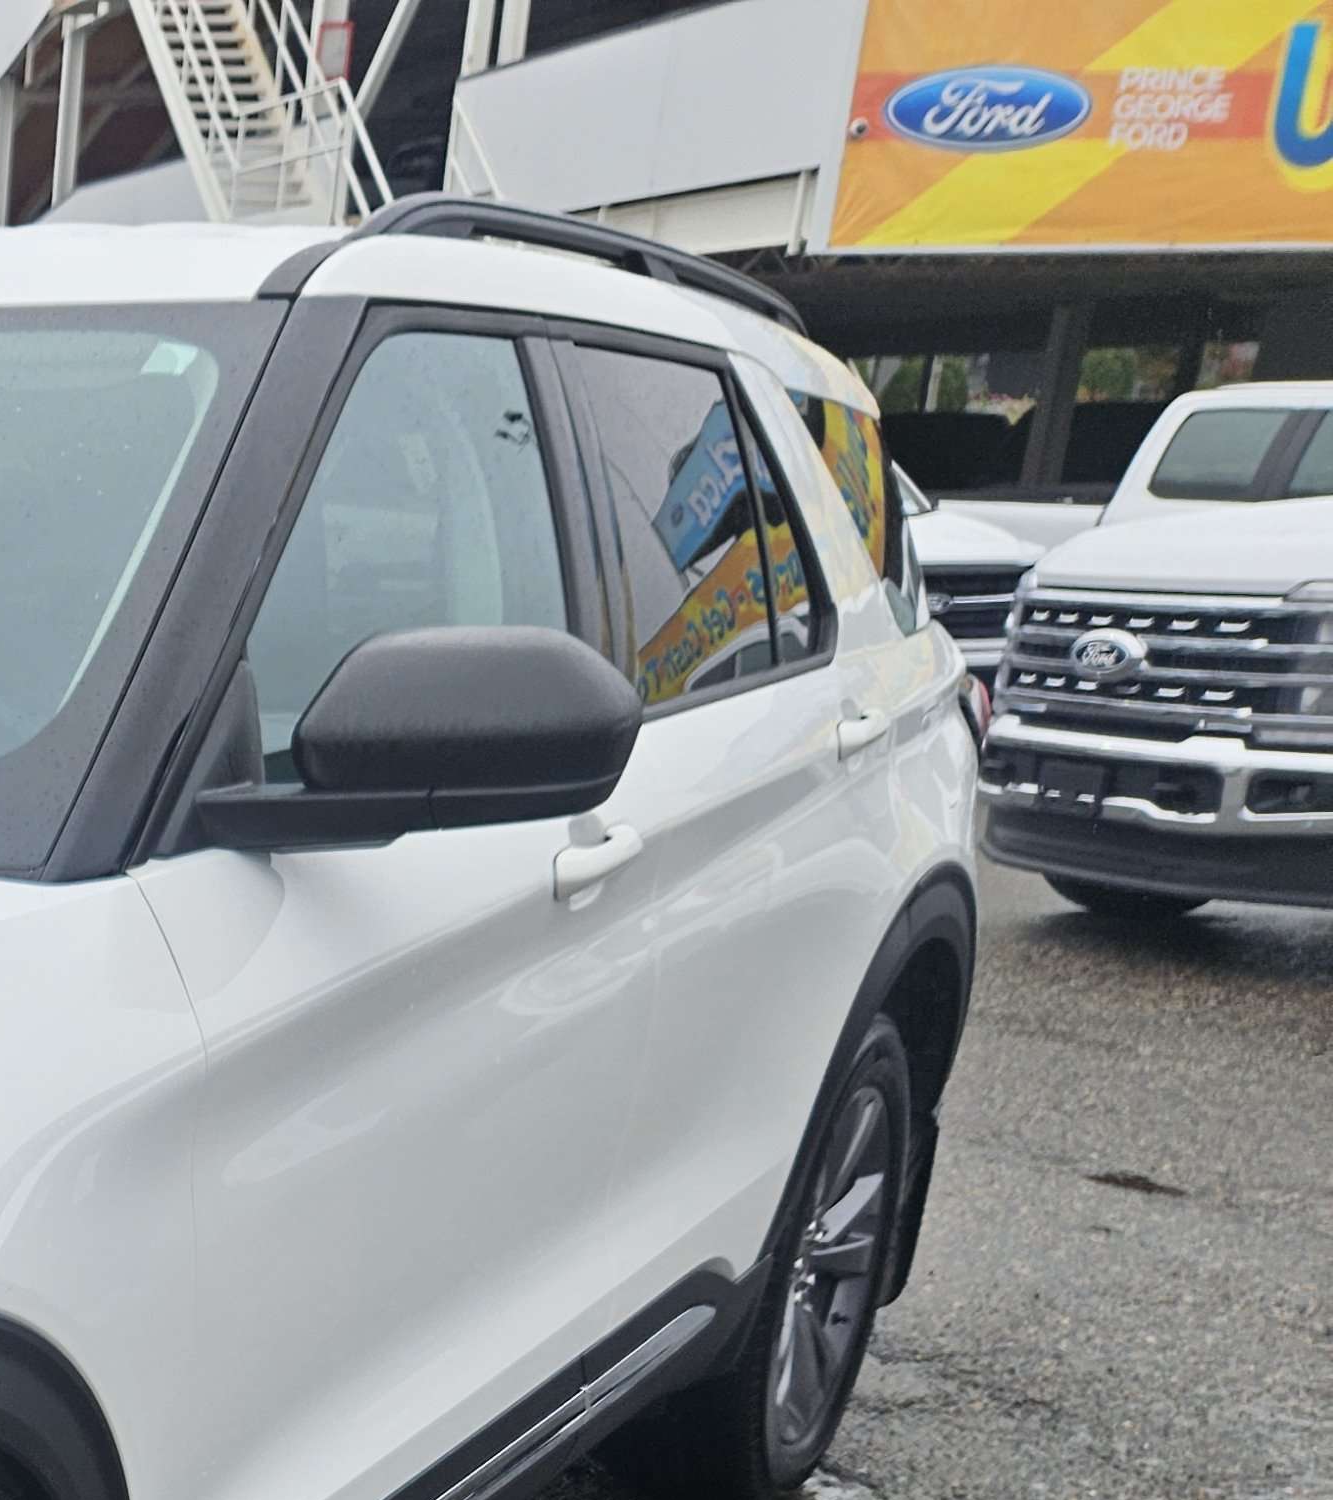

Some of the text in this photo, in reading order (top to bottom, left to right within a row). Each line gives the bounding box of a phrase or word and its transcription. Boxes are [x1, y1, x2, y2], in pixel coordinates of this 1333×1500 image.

[1119, 67, 1226, 92] PRINCE
[922, 77, 1053, 138] Ford
[1113, 93, 1233, 122] GEORGE
[1108, 122, 1189, 151] FORD
[1082, 642, 1120, 668] Ford
